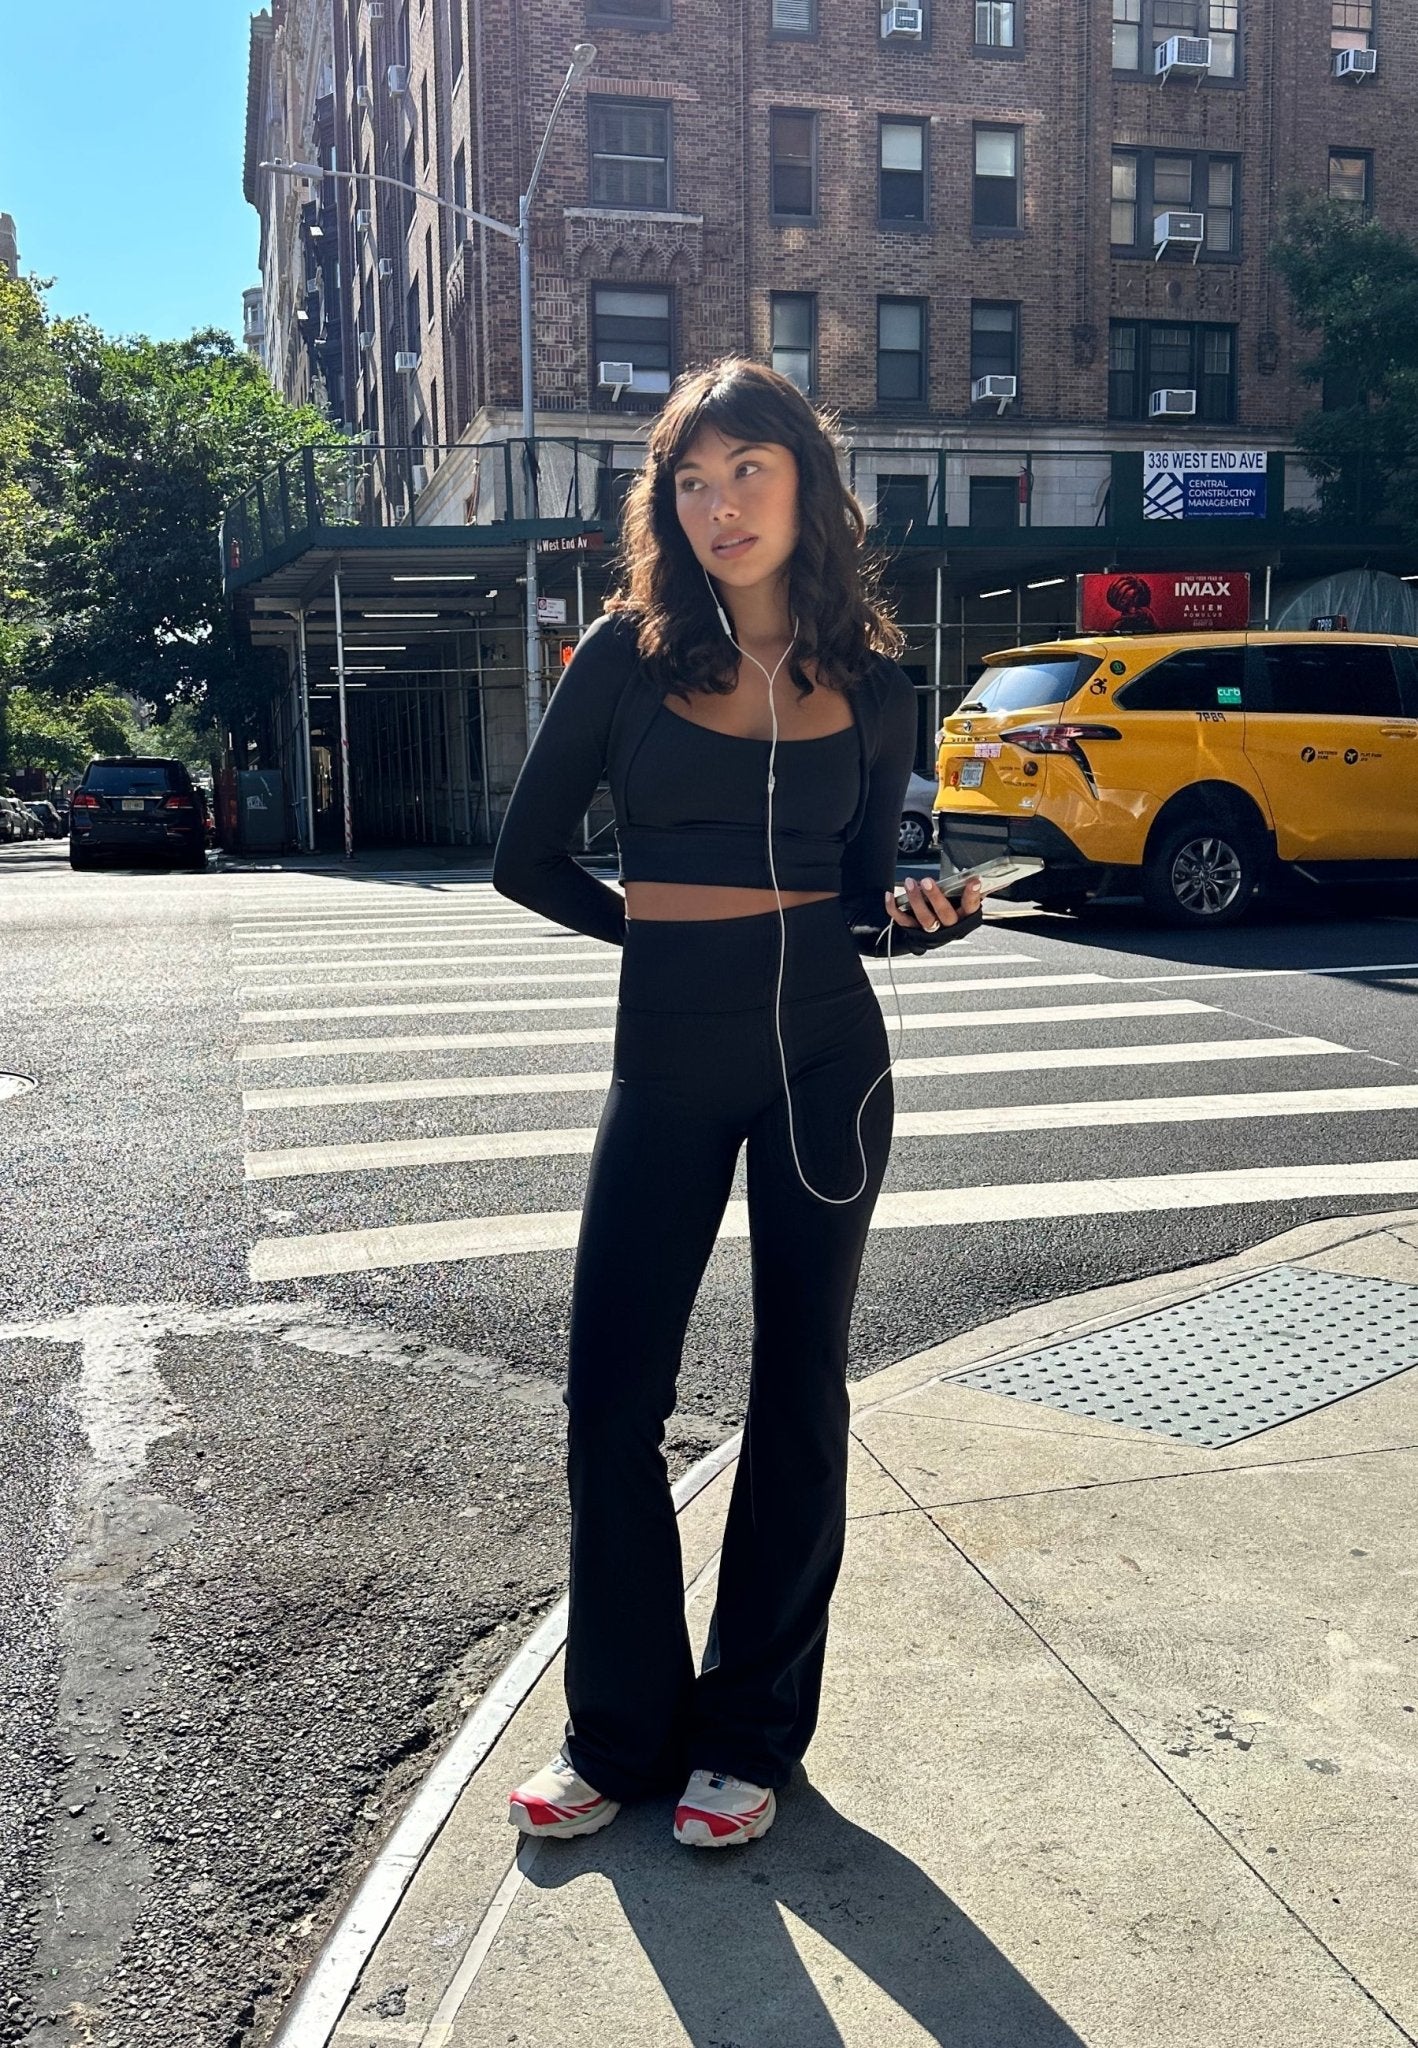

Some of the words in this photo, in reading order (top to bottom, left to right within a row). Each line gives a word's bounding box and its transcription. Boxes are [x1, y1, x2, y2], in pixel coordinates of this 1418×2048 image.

[1148, 453, 1169, 469] 336
[1172, 453, 1208, 469] WEST
[1211, 453, 1236, 469] END
[1239, 453, 1264, 469] AVE
[1189, 480, 1228, 488] CENTRAL
[1188, 489, 1256, 497] CONSTRUCTION
[1188, 498, 1251, 507] MANAGEMENT
[542, 539, 560, 552] West
[561, 537, 575, 550] End
[577, 536, 588, 548] Av
[1175, 582, 1231, 596] IMAX
[1217, 687, 1241, 696] curb
[1196, 712, 1227, 722] 7P89
